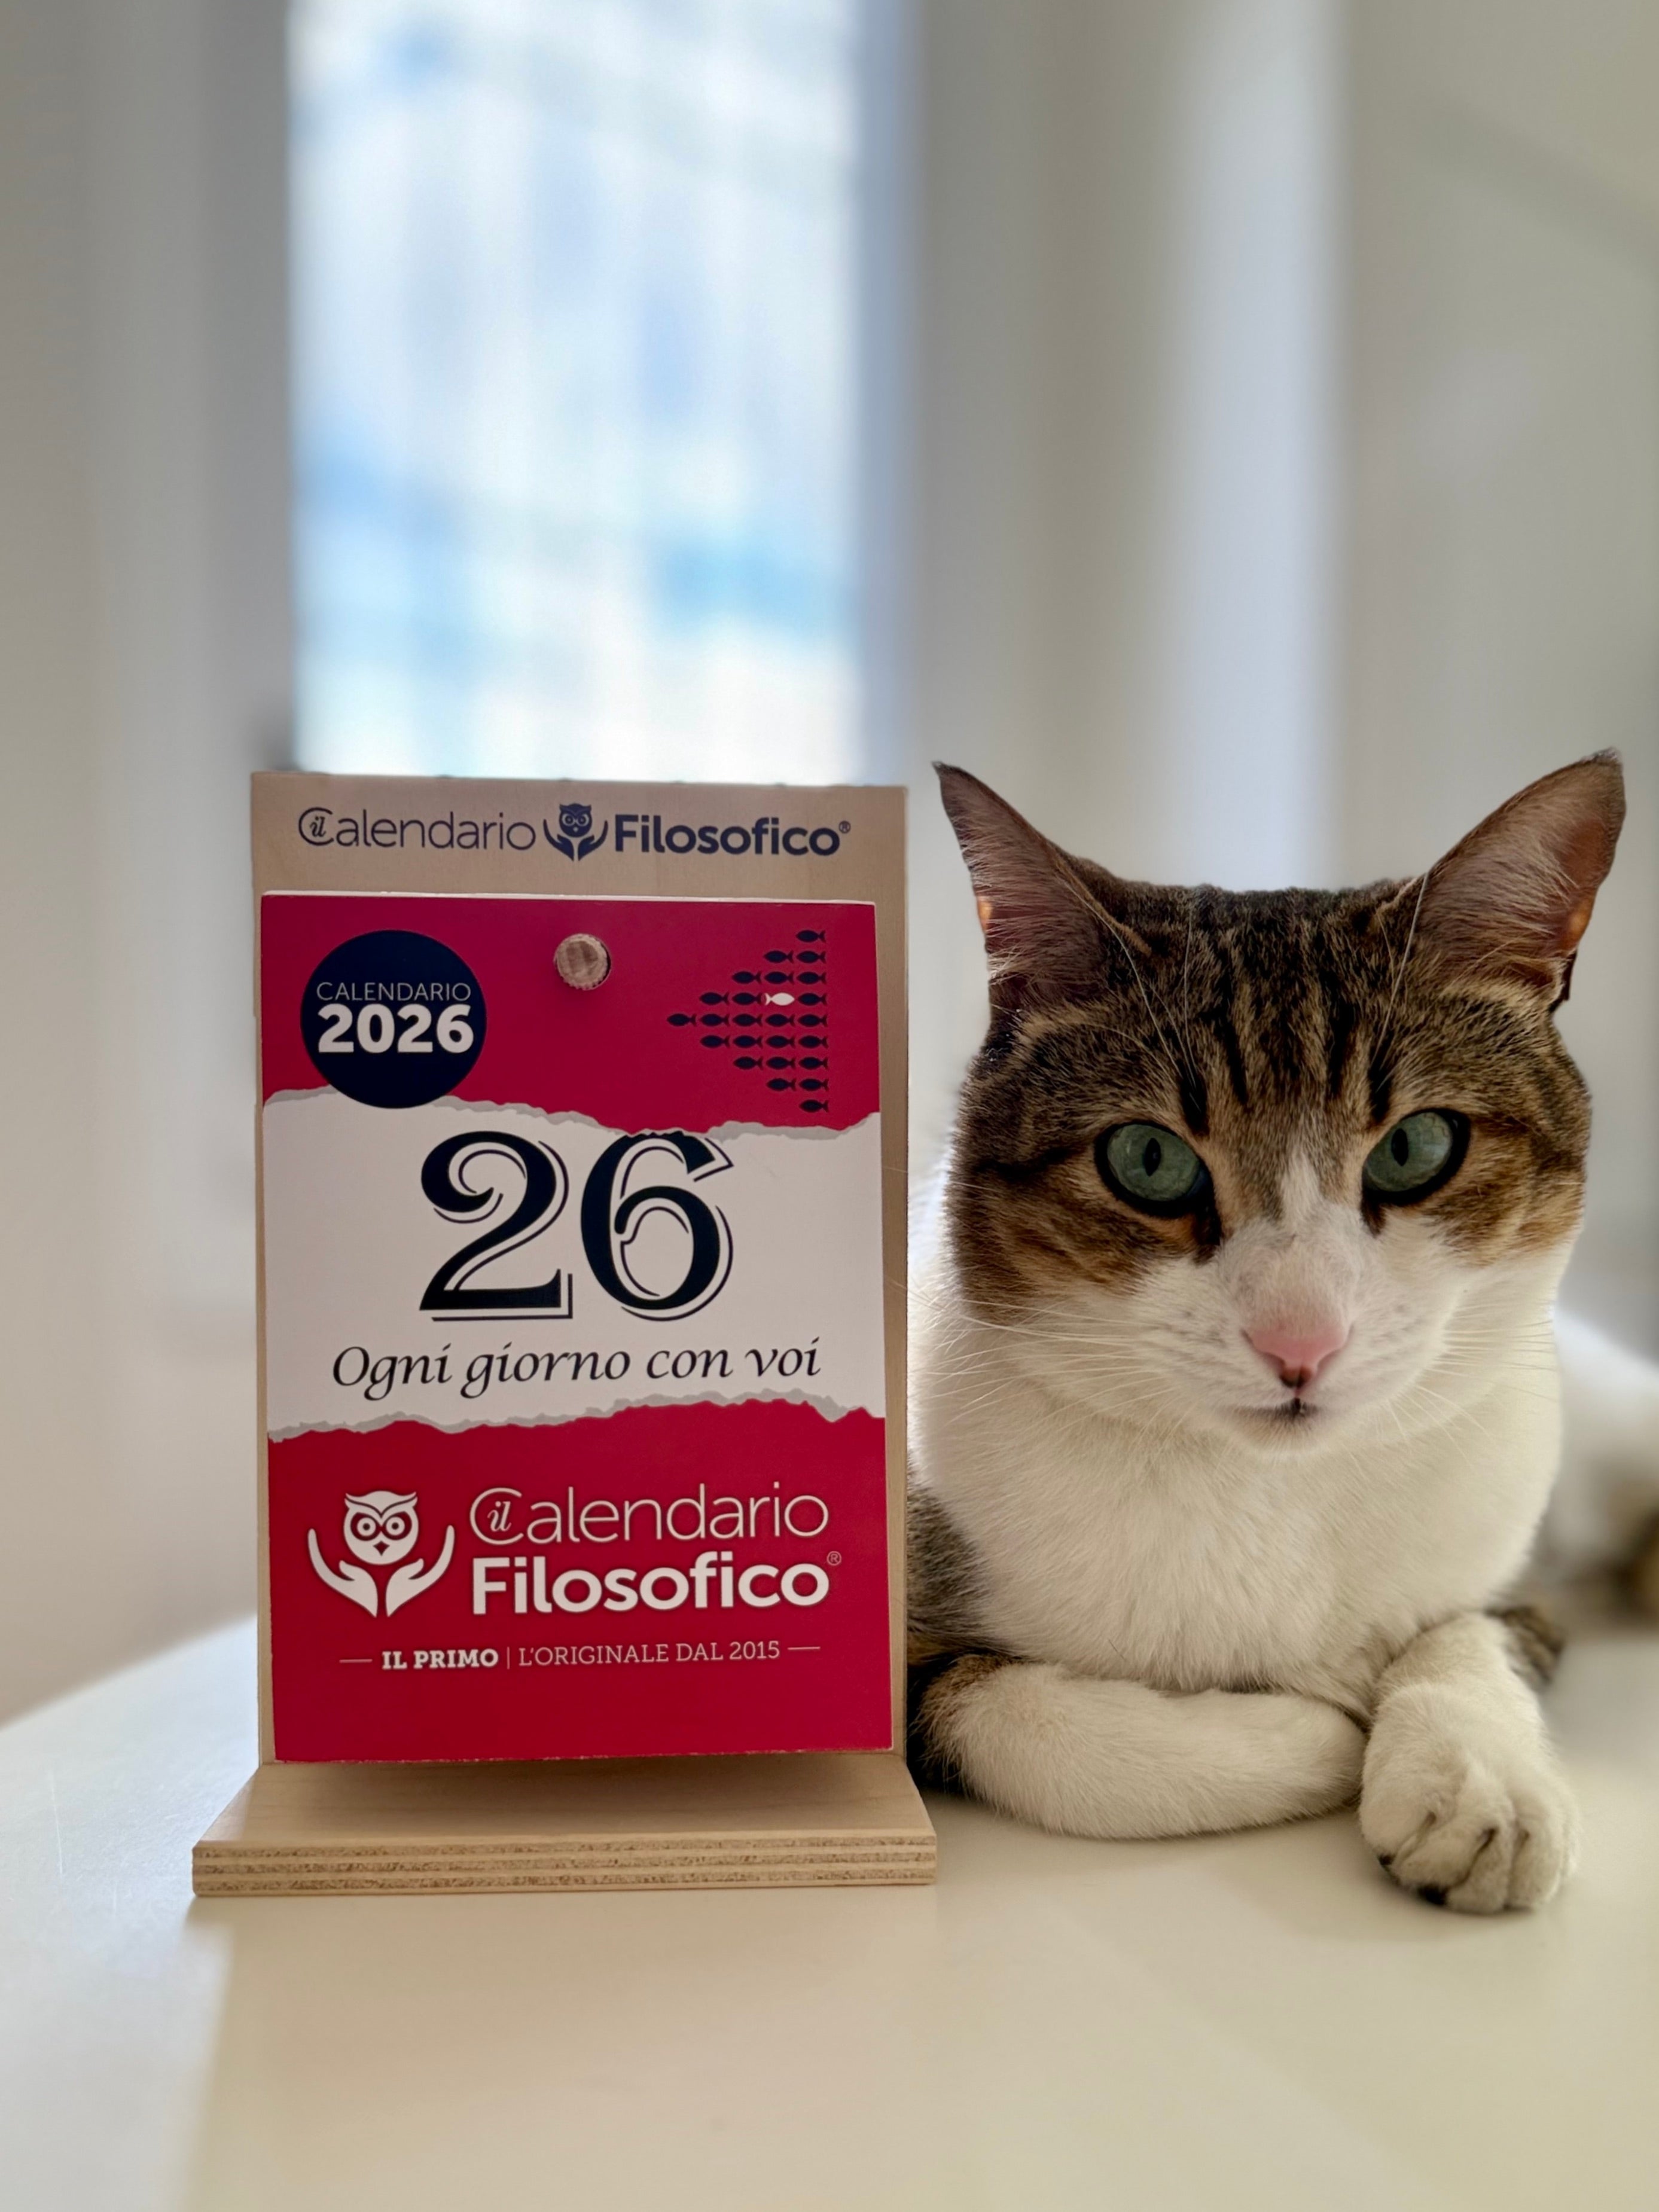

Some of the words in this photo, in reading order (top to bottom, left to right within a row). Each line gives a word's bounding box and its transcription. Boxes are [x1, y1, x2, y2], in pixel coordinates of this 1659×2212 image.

[297, 806, 536, 850] Calendario
[316, 982, 471, 1001] CALENDARIO
[318, 1003, 474, 1054] 2026
[419, 1130, 734, 1322] 26
[333, 1343, 452, 1401] Ogni
[460, 1341, 631, 1399] giorno
[646, 1346, 733, 1378] con
[745, 1337, 822, 1377] voi
[469, 1481, 830, 1545] Calendario
[486, 1500, 513, 1533] il
[382, 1650, 408, 1670] IL
[413, 1649, 499, 1669] PRIMO
[518, 1643, 669, 1666] L'ORIGINALE
[675, 1642, 724, 1661] DAL
[728, 1640, 780, 1659] 2015
